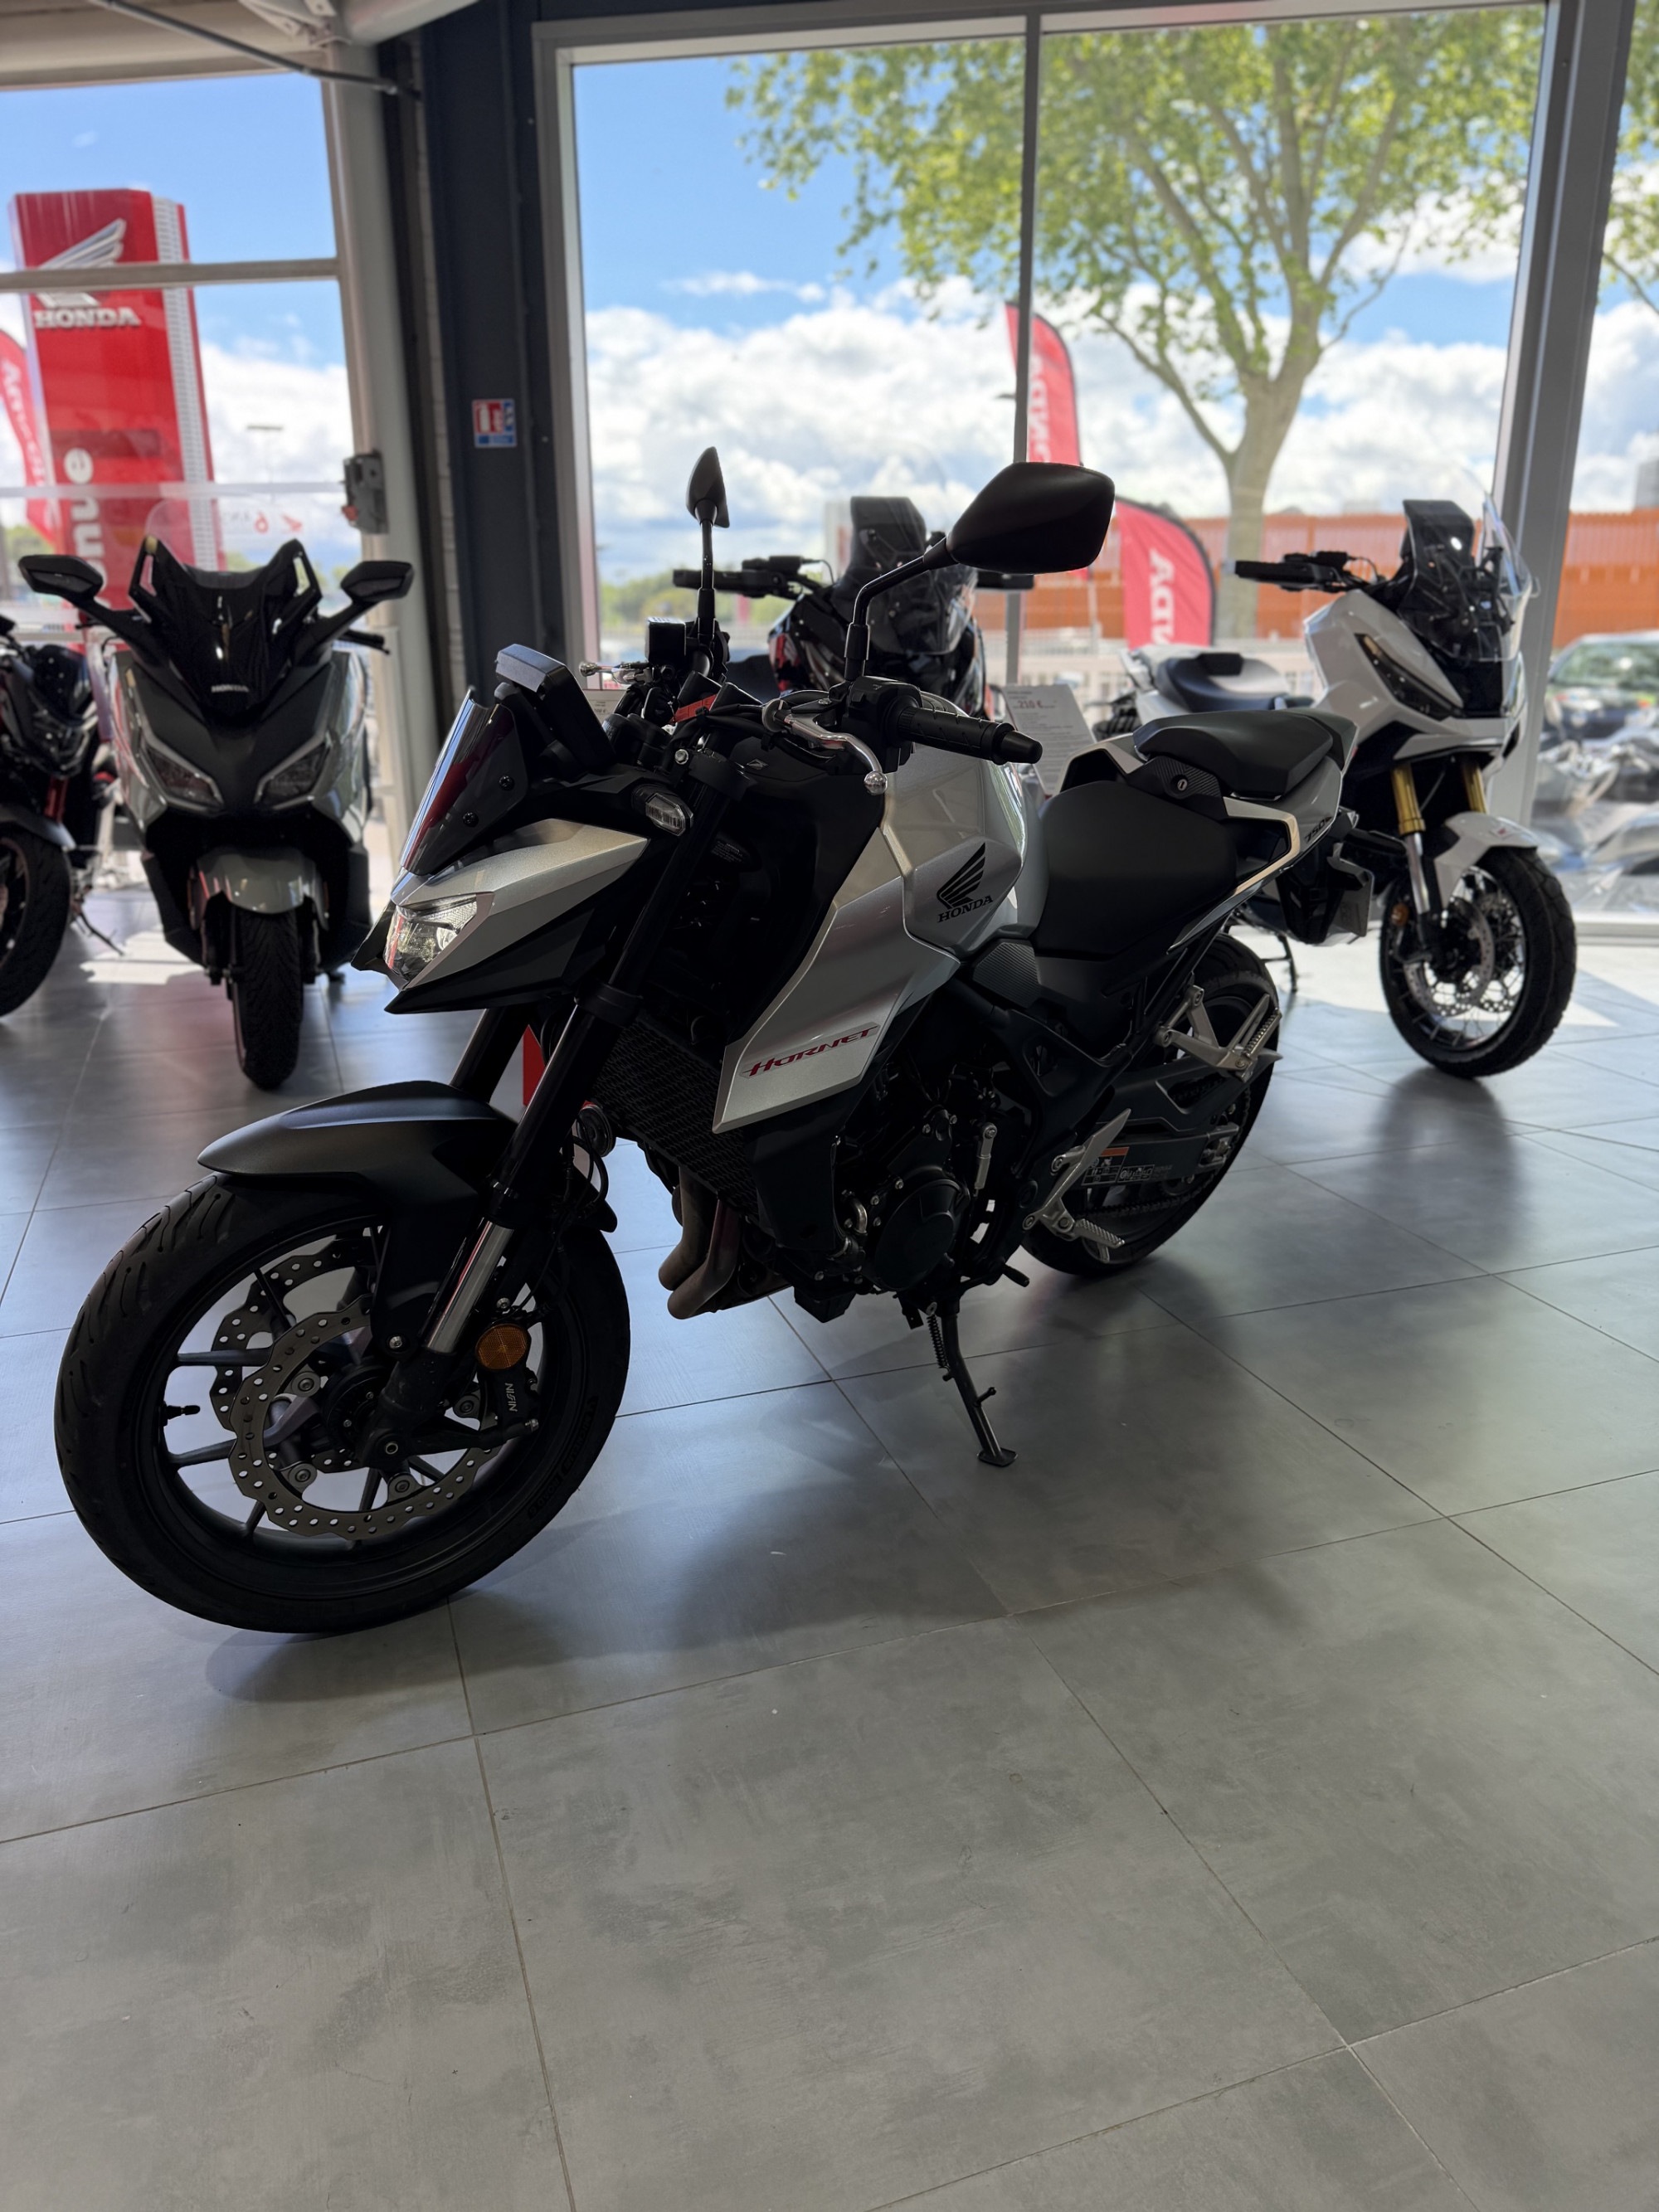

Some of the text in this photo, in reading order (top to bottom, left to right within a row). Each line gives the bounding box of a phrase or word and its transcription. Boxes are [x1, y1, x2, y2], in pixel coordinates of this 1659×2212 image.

[34, 308, 141, 329] HONDA
[937, 895, 994, 923] HONDA
[742, 1025, 878, 1077] HORNET
